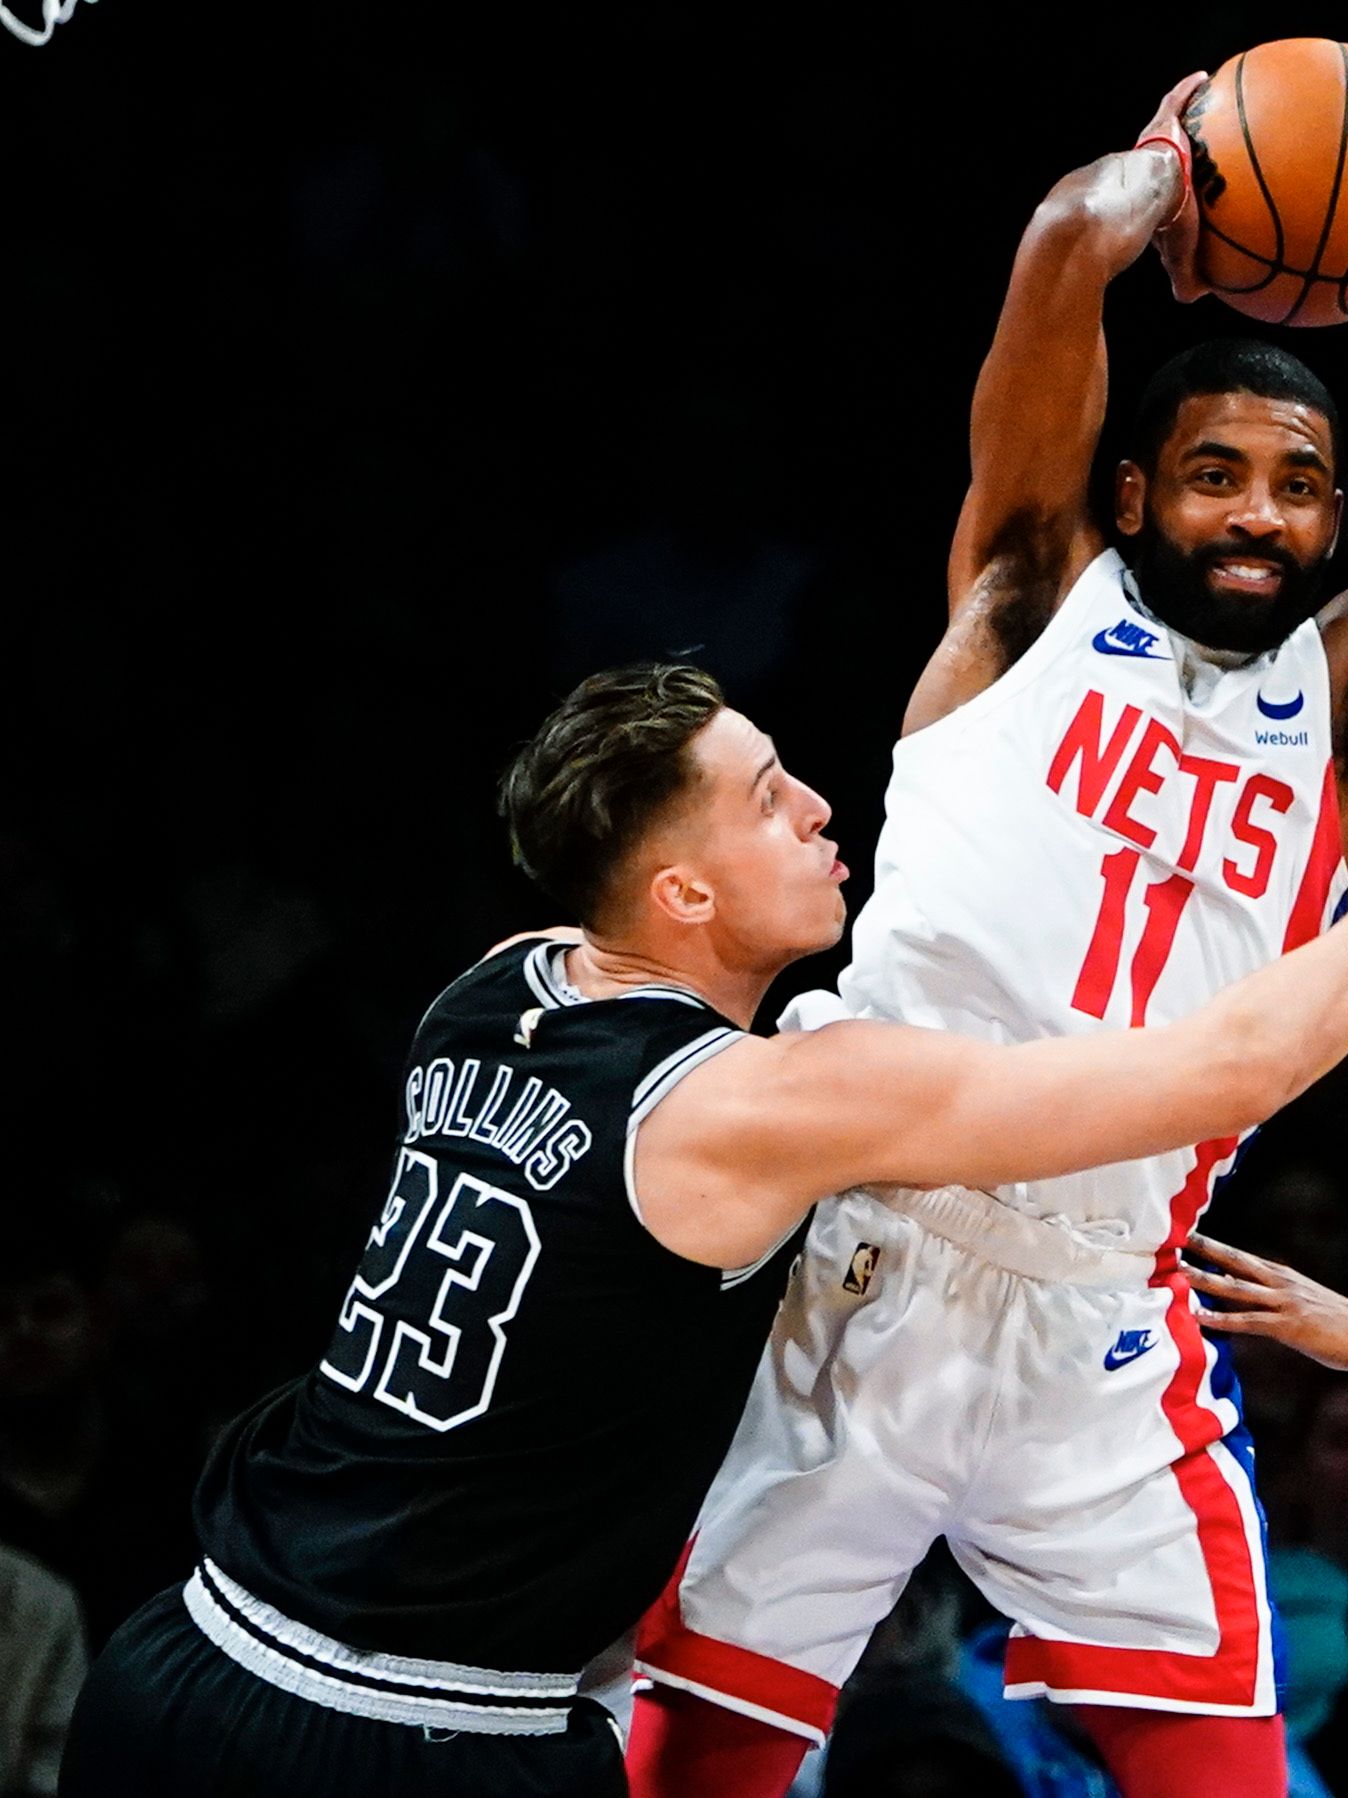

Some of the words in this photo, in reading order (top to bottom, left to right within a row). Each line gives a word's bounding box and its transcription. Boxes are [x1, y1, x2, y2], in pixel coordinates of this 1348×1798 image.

[1108, 618, 1160, 653] NIKE
[1045, 689, 1294, 900] NETS
[1254, 730, 1308, 746] Webull
[1071, 846, 1195, 1029] 11
[404, 1057, 592, 1191] COLLINS
[319, 1146, 542, 1432] 23
[1114, 1329, 1152, 1354] NIKE
